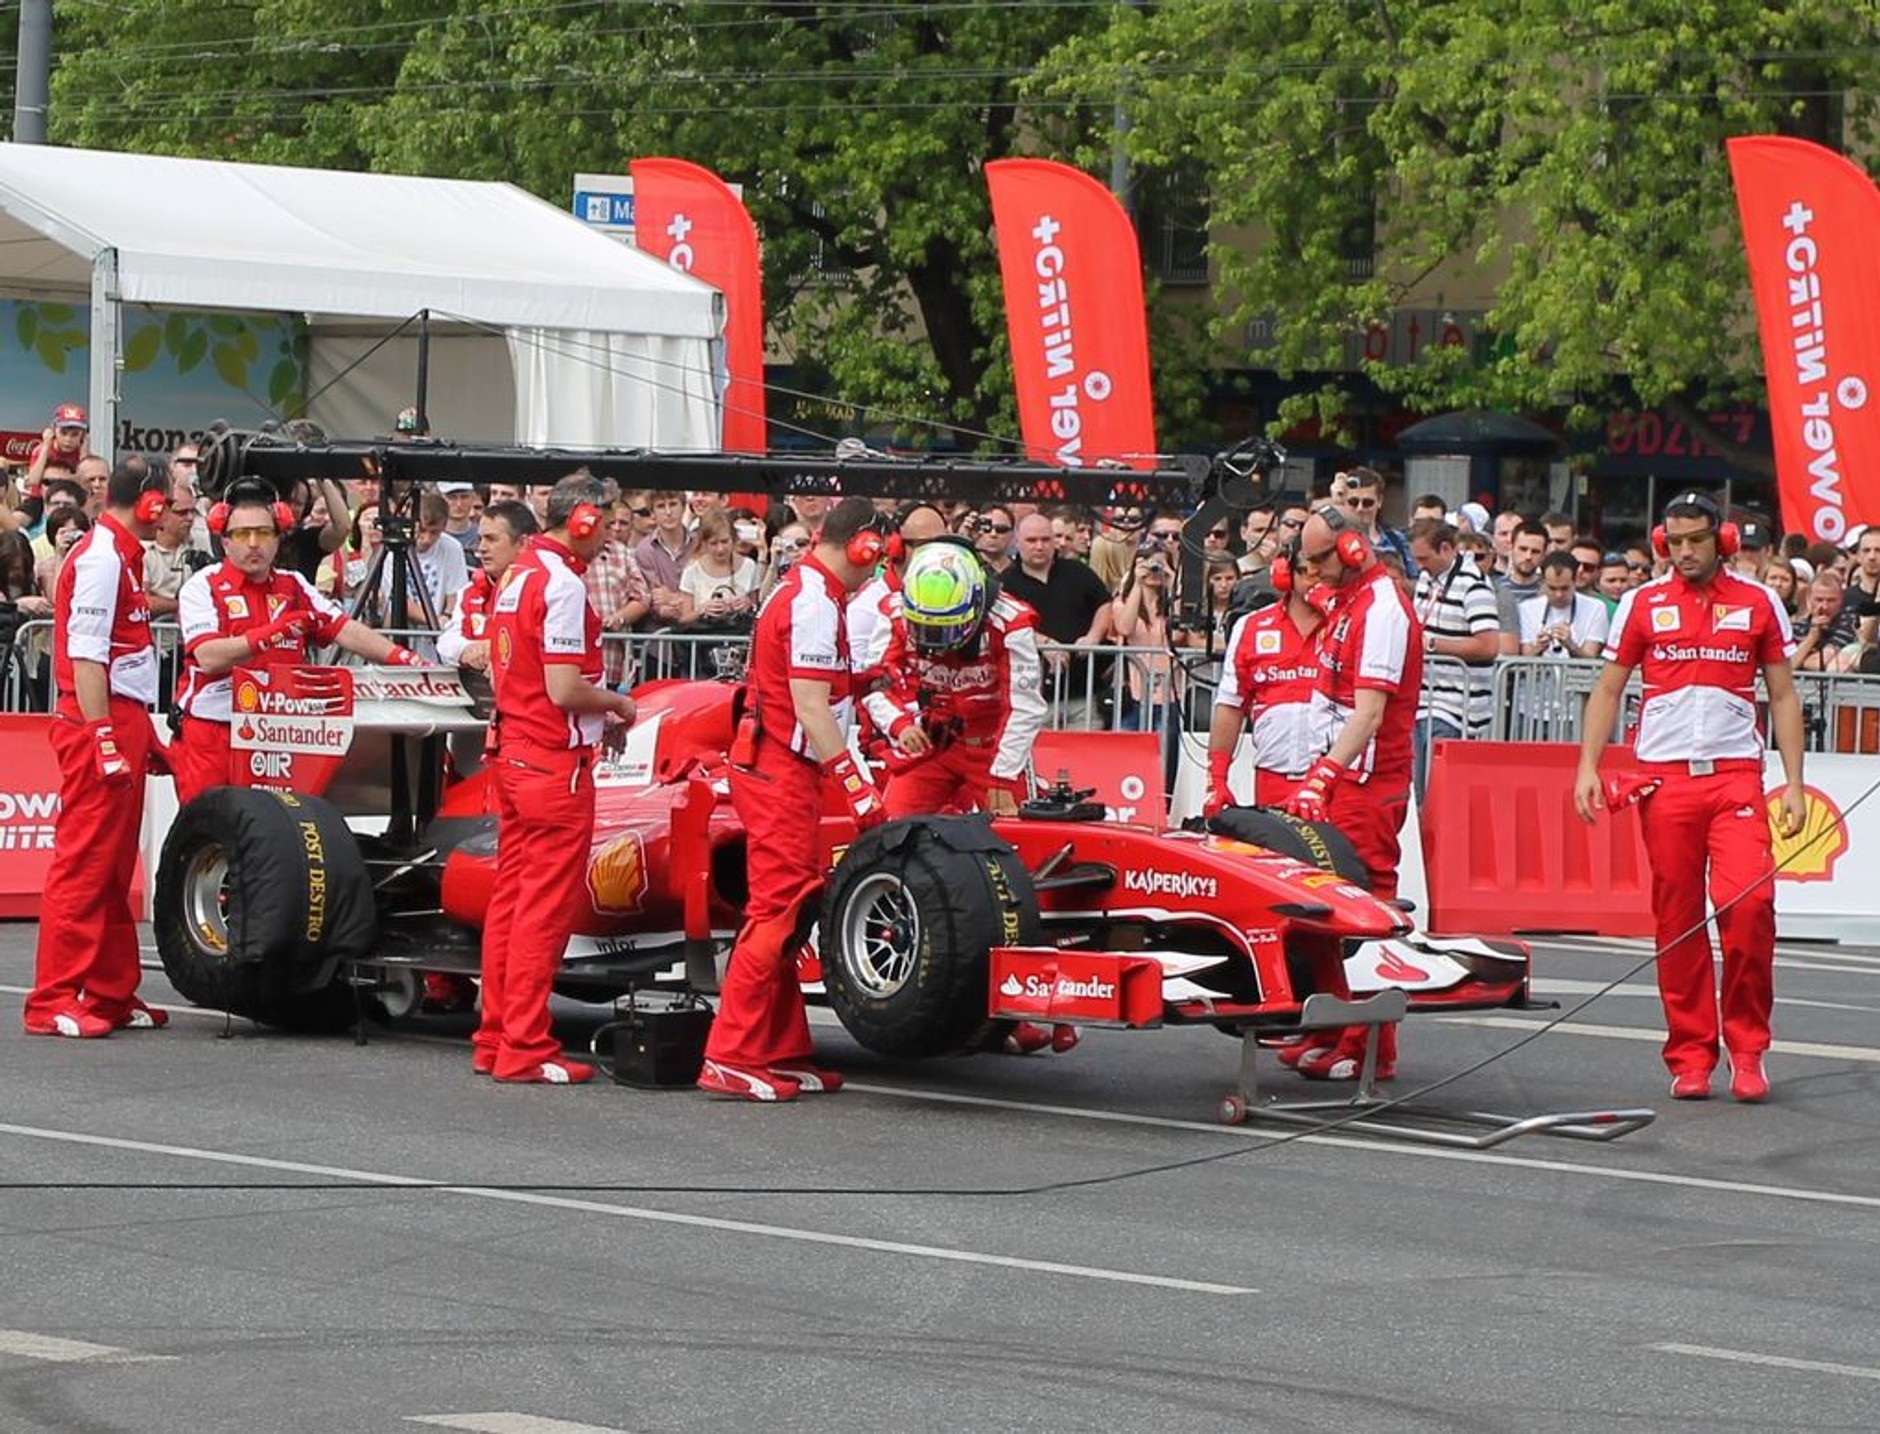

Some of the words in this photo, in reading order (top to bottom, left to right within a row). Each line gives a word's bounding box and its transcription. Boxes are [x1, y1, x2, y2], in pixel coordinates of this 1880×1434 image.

[257, 717, 344, 746] Santander
[300, 820, 326, 864] POST
[1125, 867, 1208, 898] KASPERSKY
[306, 868, 327, 943] DESTRO
[1025, 974, 1115, 999] Satander
